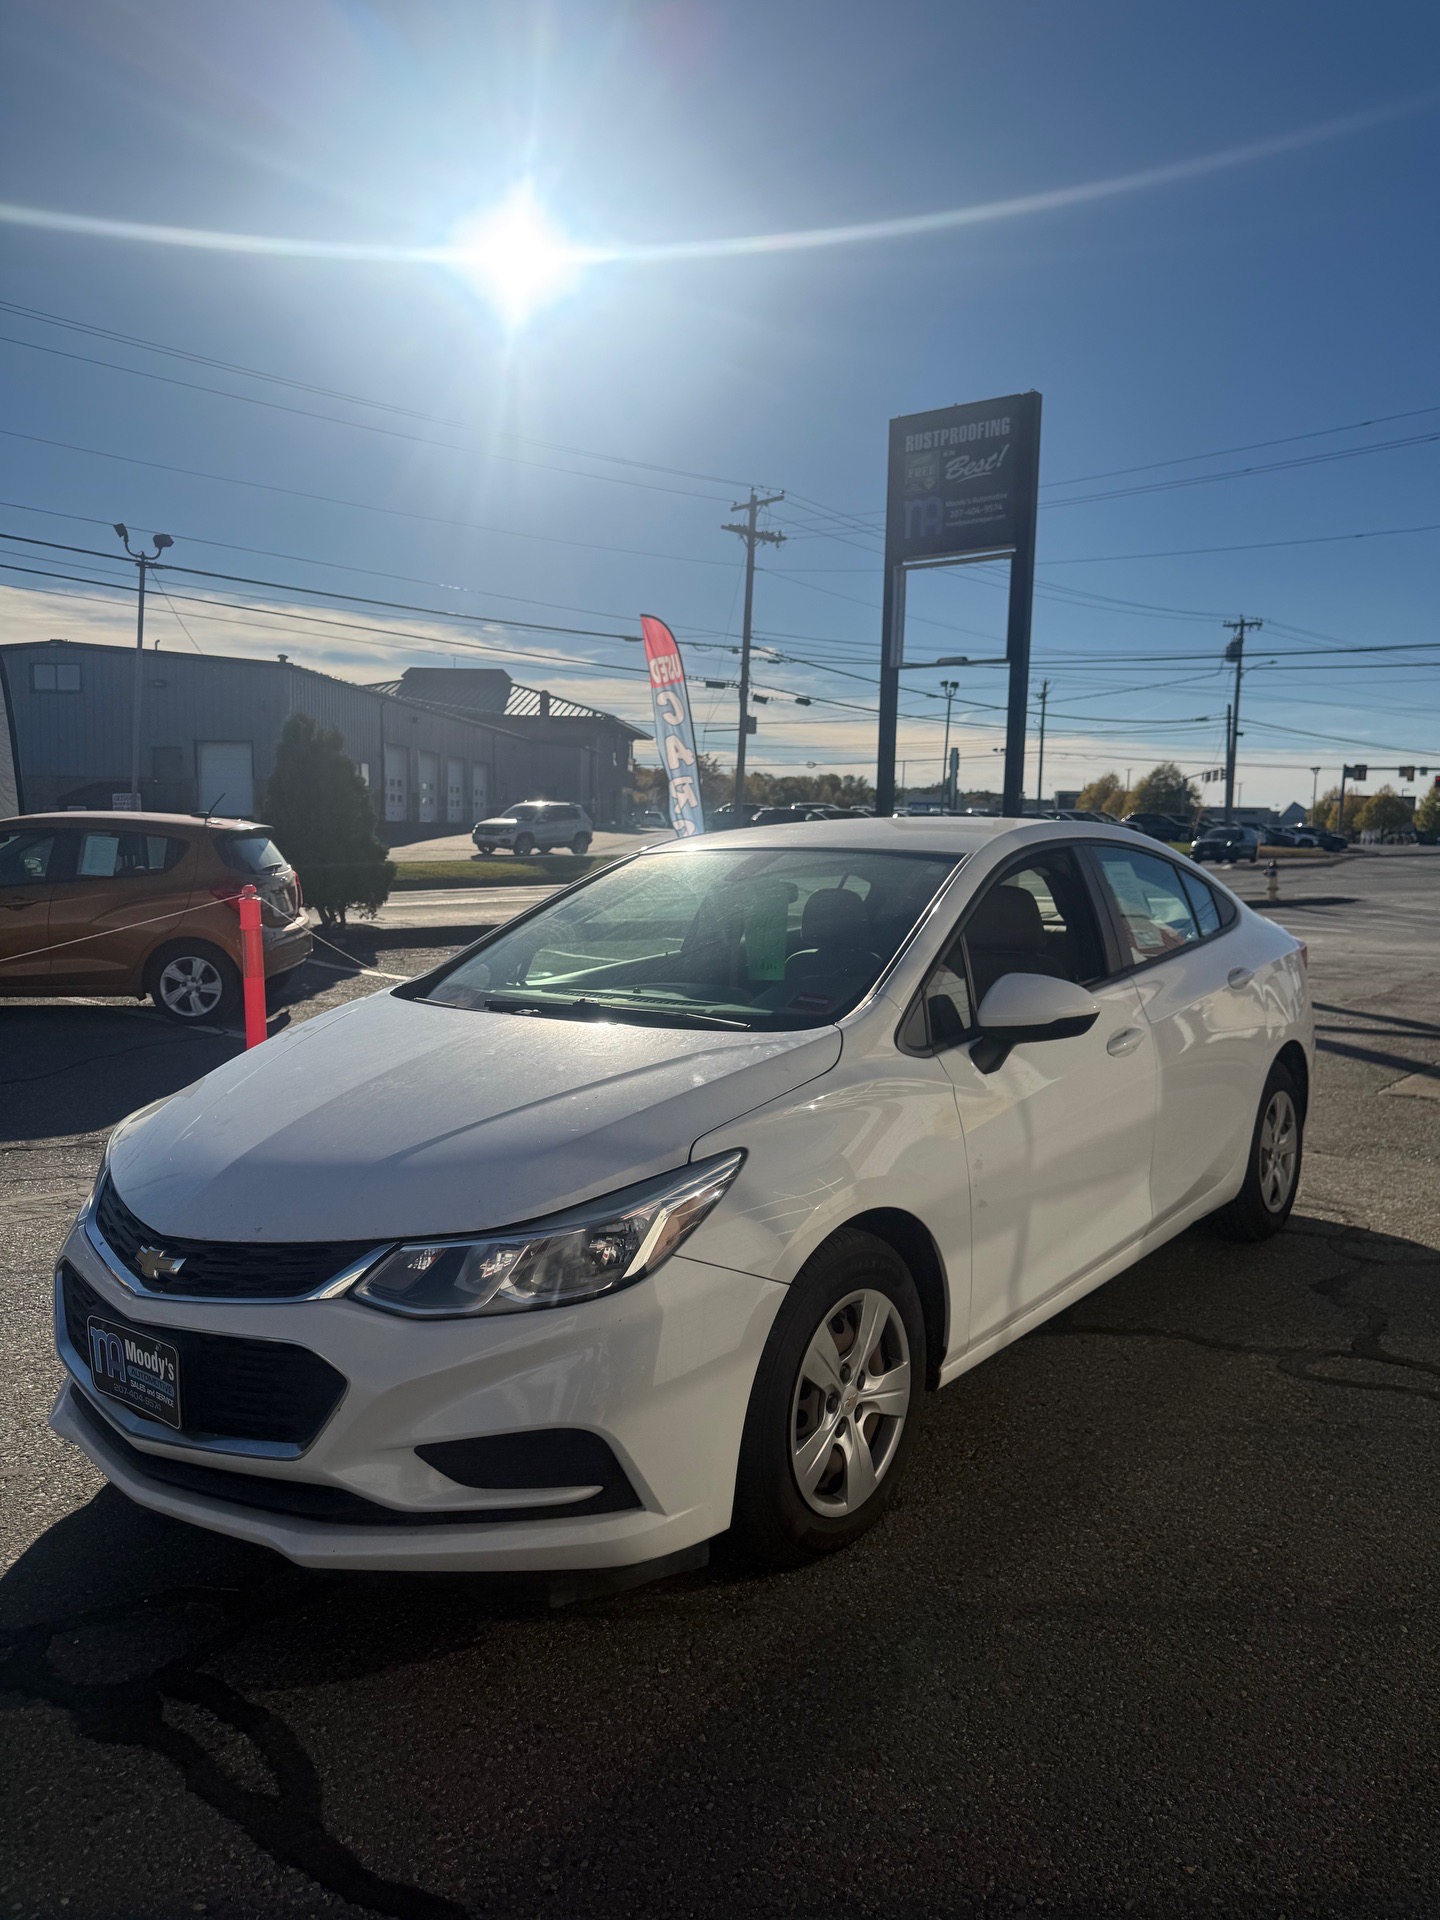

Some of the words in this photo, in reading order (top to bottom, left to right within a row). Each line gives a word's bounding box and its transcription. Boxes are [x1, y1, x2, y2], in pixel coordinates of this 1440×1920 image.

[905, 416, 1011, 453] RUSTPROOFING
[944, 443, 1010, 481] Best!
[124, 1339, 175, 1382] Moody's
[113, 1383, 162, 1411] 207-404-9574
[130, 1379, 146, 1393] SALES
[146, 1388, 156, 1398] and
[155, 1391, 175, 1408] SERVICE
[131, 1368, 174, 1395] AUTOMOTIVE
